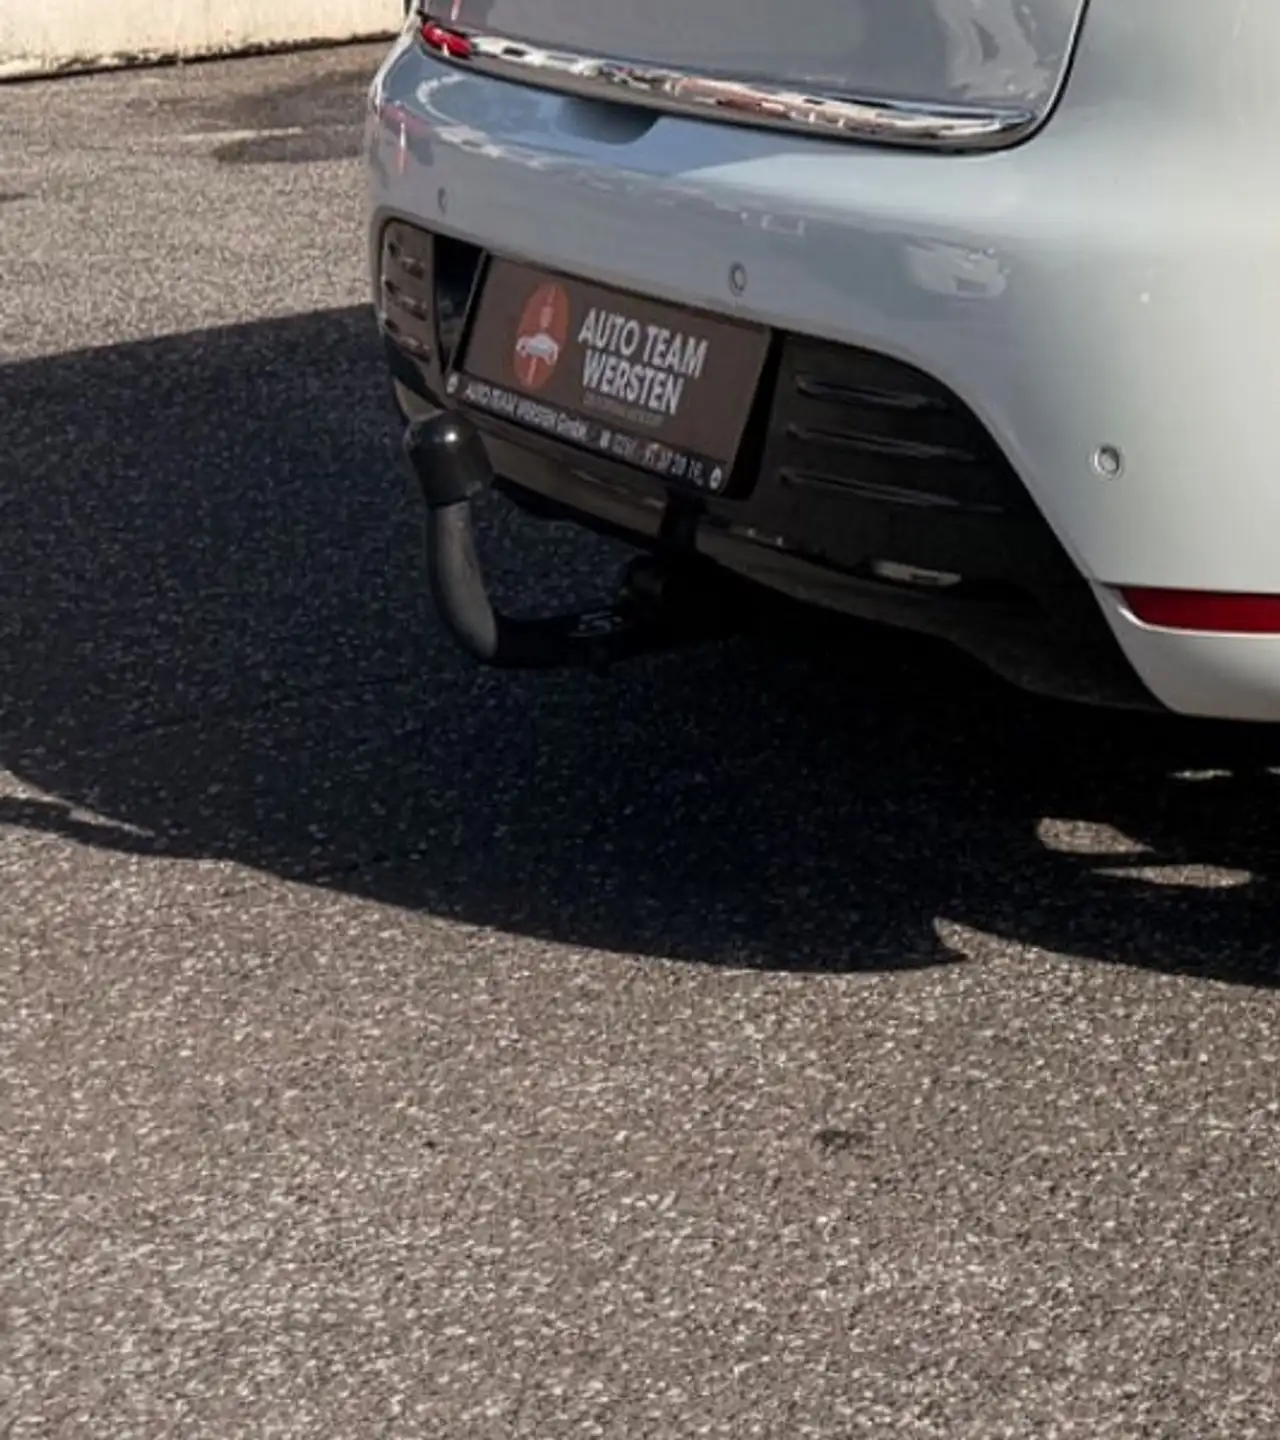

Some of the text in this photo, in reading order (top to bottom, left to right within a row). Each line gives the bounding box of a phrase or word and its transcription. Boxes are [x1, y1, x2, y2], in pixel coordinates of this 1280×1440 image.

[578, 307, 709, 380] AUTO TEAM
[582, 348, 685, 417] WERSTEN
